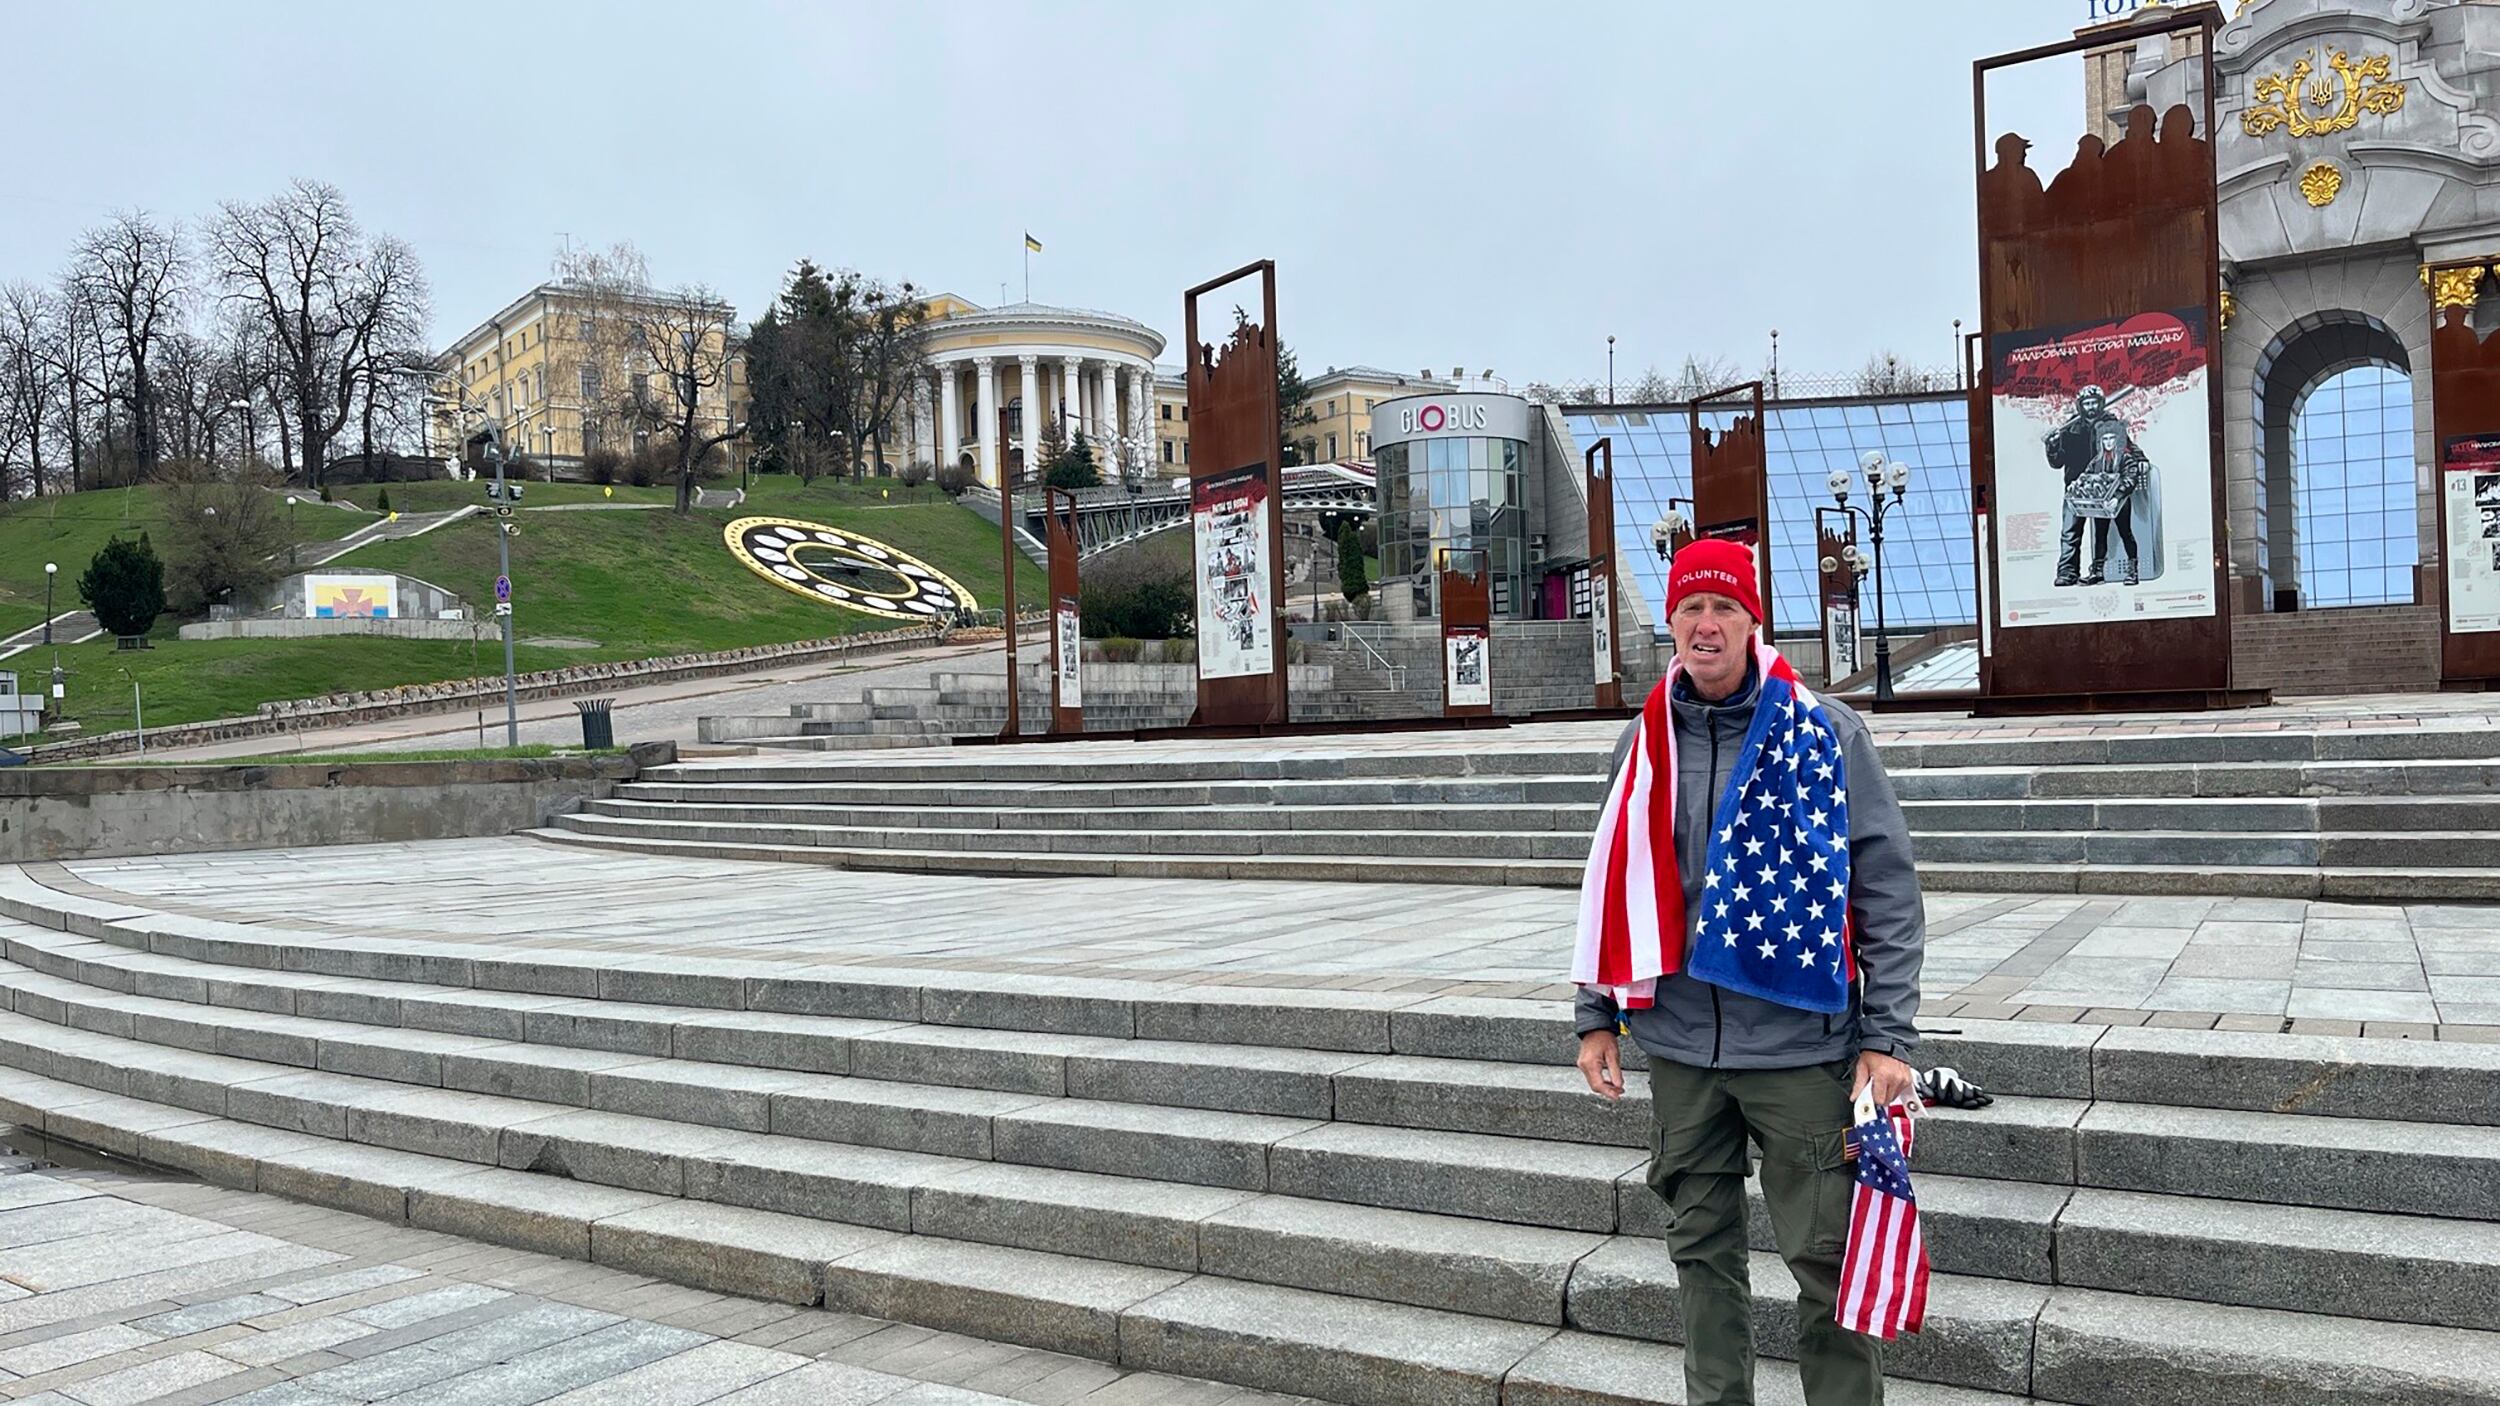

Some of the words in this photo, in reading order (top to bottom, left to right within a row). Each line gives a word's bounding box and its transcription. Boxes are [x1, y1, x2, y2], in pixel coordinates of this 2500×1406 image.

[2012, 345, 2079, 363] МАЛЬОВАНА
[2127, 331, 2184, 348] МАЙДАНУ
[1400, 403, 1488, 434] GLOBUS
[1676, 569, 1738, 588] VOLUNTEER
